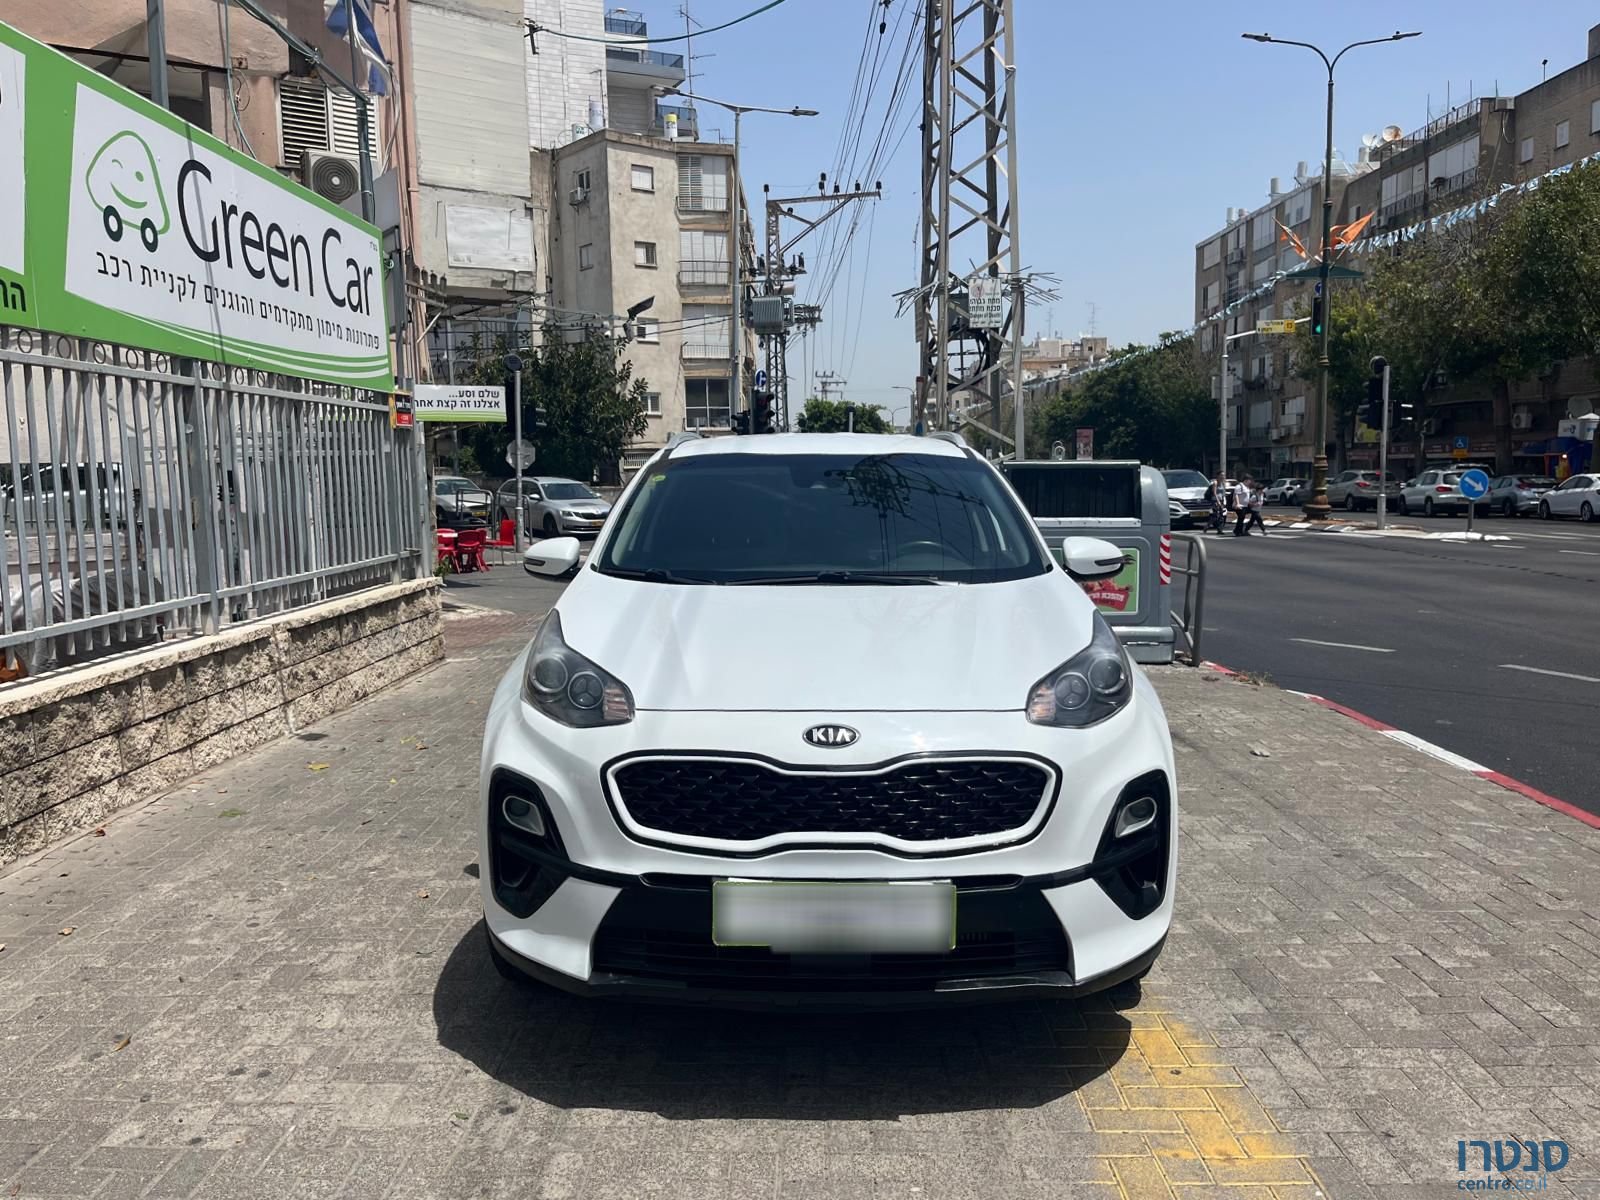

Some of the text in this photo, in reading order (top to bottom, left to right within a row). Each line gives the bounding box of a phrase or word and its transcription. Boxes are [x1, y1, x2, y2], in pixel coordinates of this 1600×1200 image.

[177, 159, 373, 316] Green Car
[96, 251, 380, 350] פתרונות מימון מתקדמים והוגנים לקניית רכב
[448, 389, 500, 398] שלם וסע...
[415, 399, 500, 410] אצלנו זה קצת אחר
[812, 727, 851, 743] KIA
